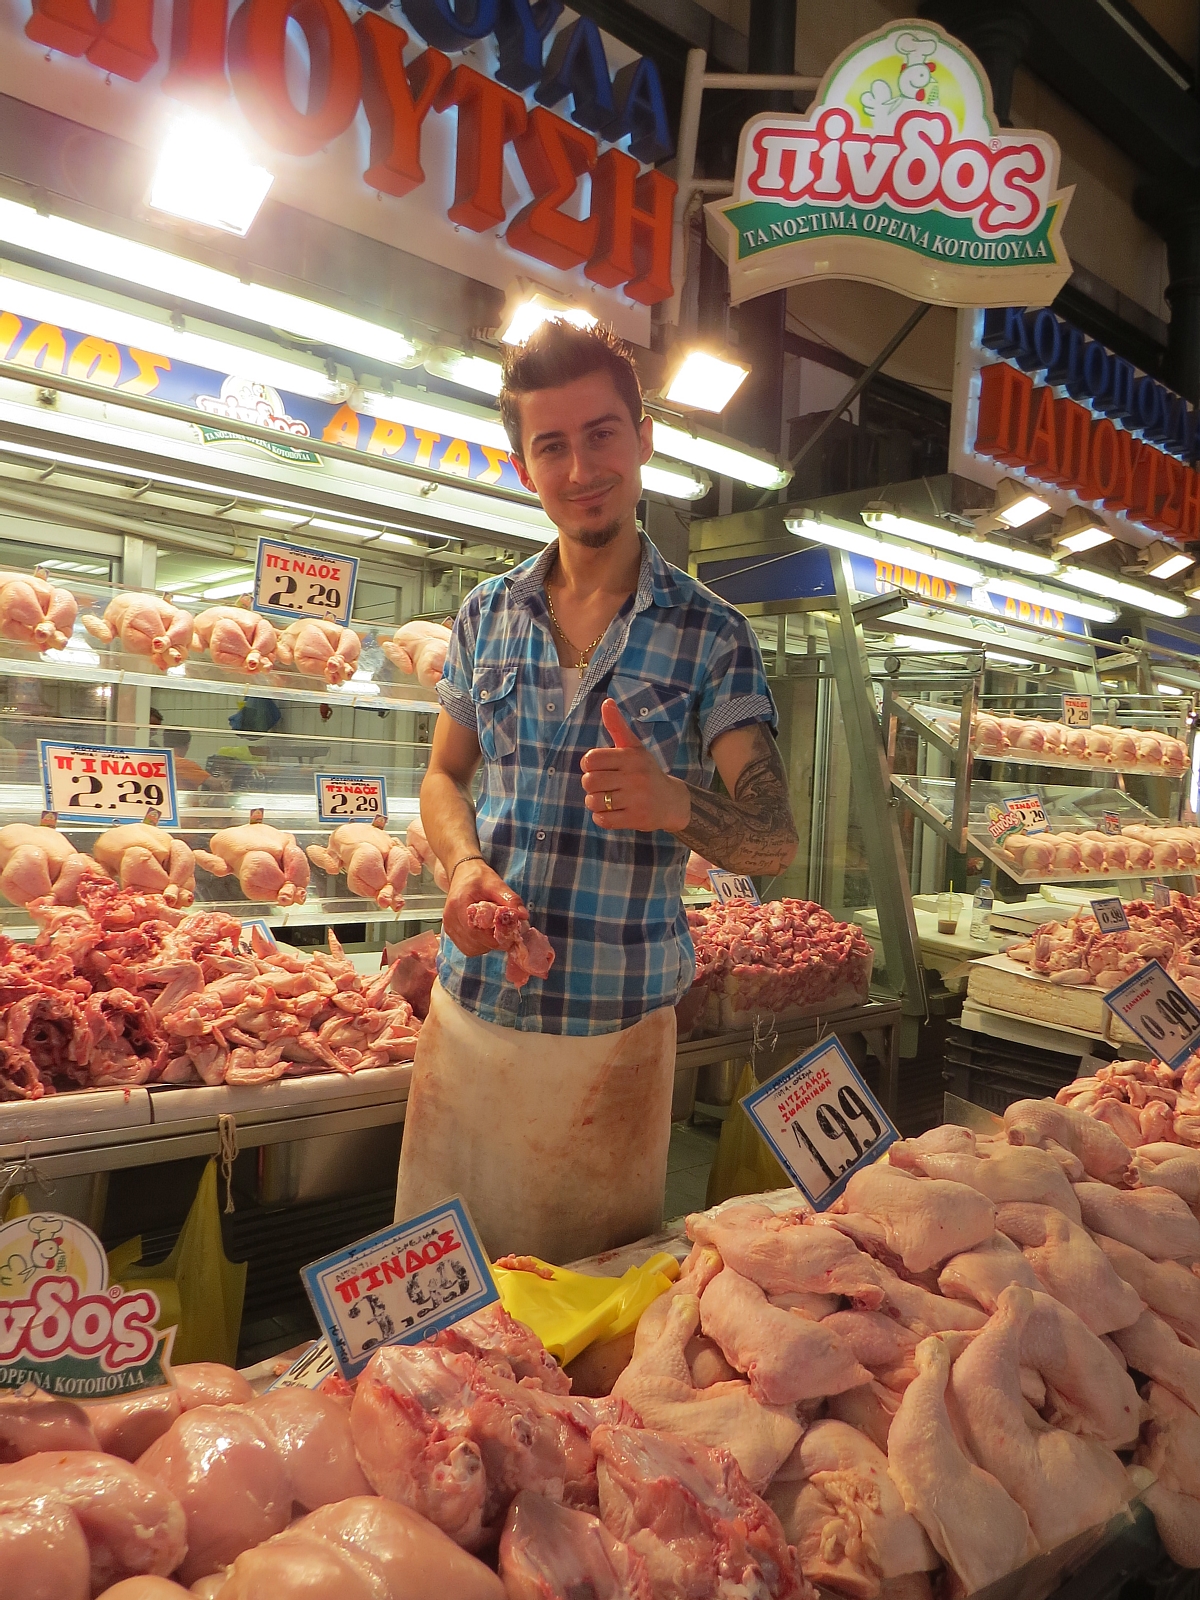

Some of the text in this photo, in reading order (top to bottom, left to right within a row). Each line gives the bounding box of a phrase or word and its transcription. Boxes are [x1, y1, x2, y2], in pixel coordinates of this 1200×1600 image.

[744, 211, 1048, 260] ΤΑ ΝΟΣΤΙΜΑ ΟΡΕΙΝΑ ΚΟΤΟΠΟΥΛΑ
[266, 553, 341, 581] ΠΙΝΔΟΣ
[54, 756, 167, 778] ΠΙΝΔΟΣ
[325, 784, 378, 796] ΠΙΝΔΟΣ
[335, 1229, 462, 1304] ΠΙΝΔΟΣ
[54, 1370, 145, 1394] ΚΟΤΟΠΟΥΛΑ
